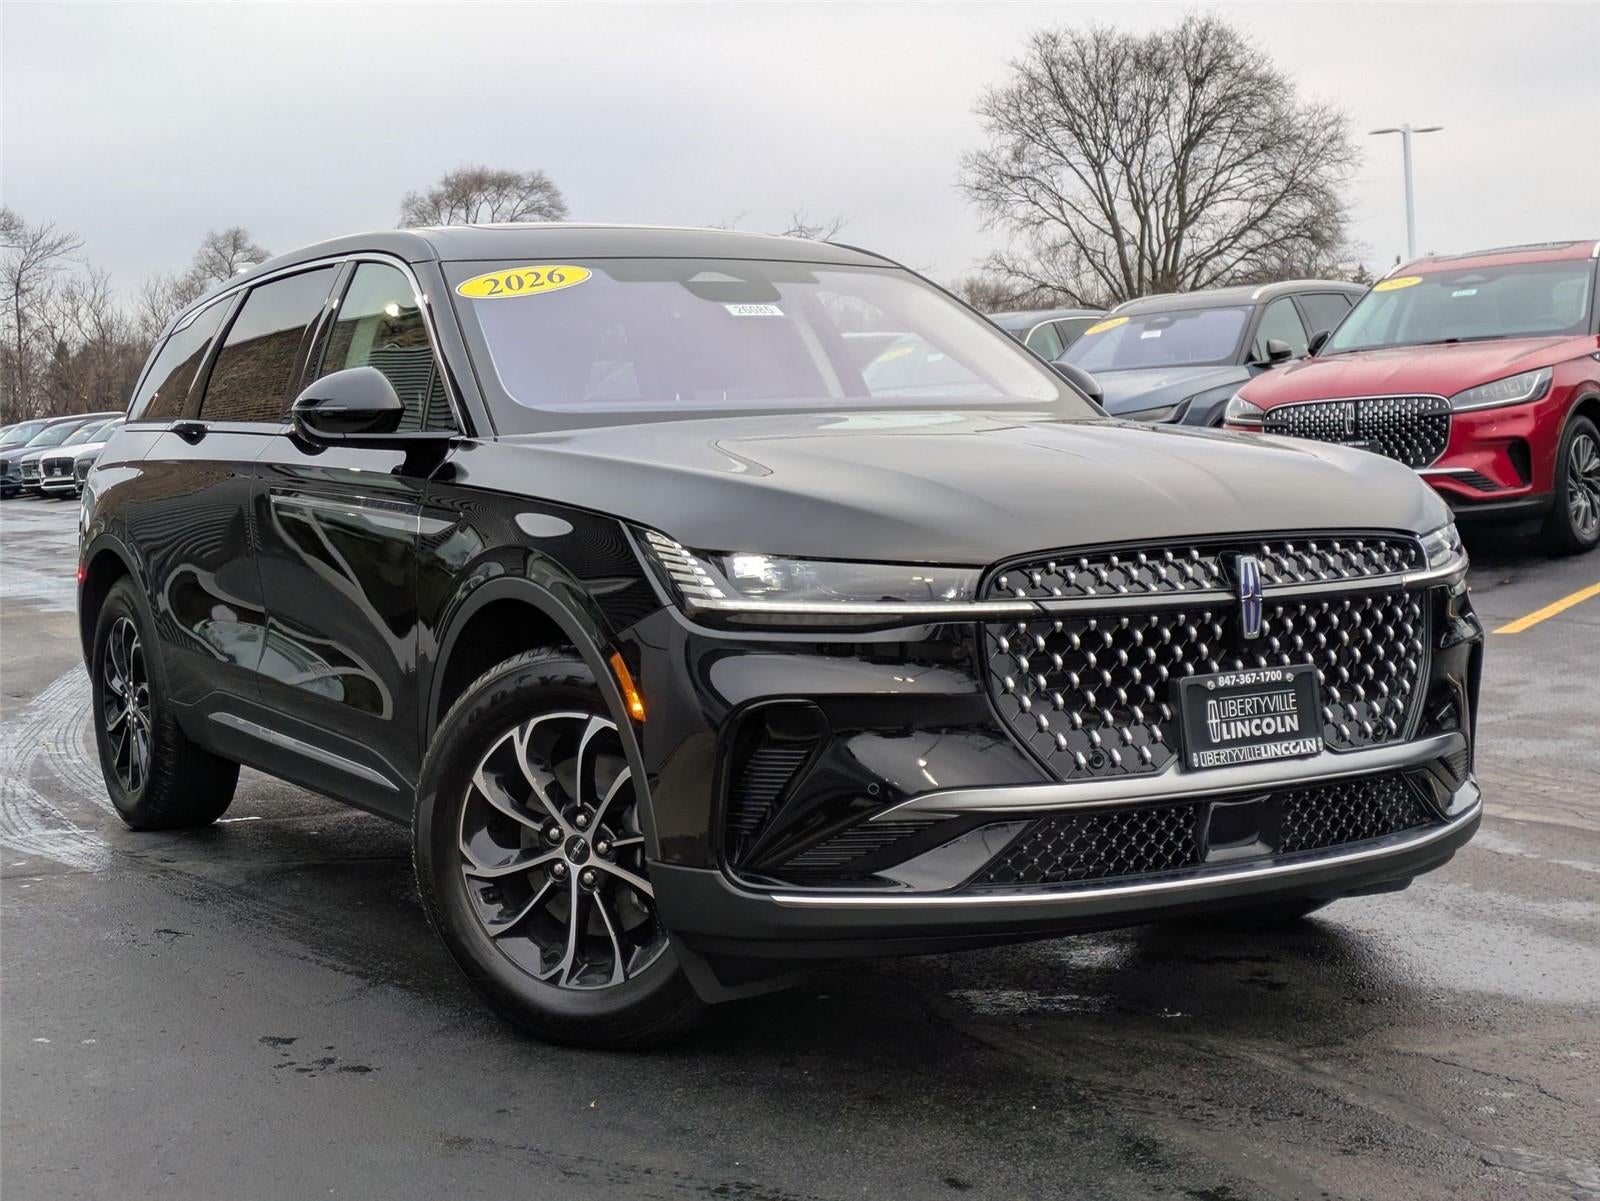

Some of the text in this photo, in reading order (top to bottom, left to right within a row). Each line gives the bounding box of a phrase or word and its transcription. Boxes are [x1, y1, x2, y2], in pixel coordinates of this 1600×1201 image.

[483, 268, 566, 296] 2026
[1218, 670, 1282, 686] 847-367-1700
[1220, 692, 1297, 718] LIBERTYVILLE
[1221, 714, 1300, 740] LINCOLN
